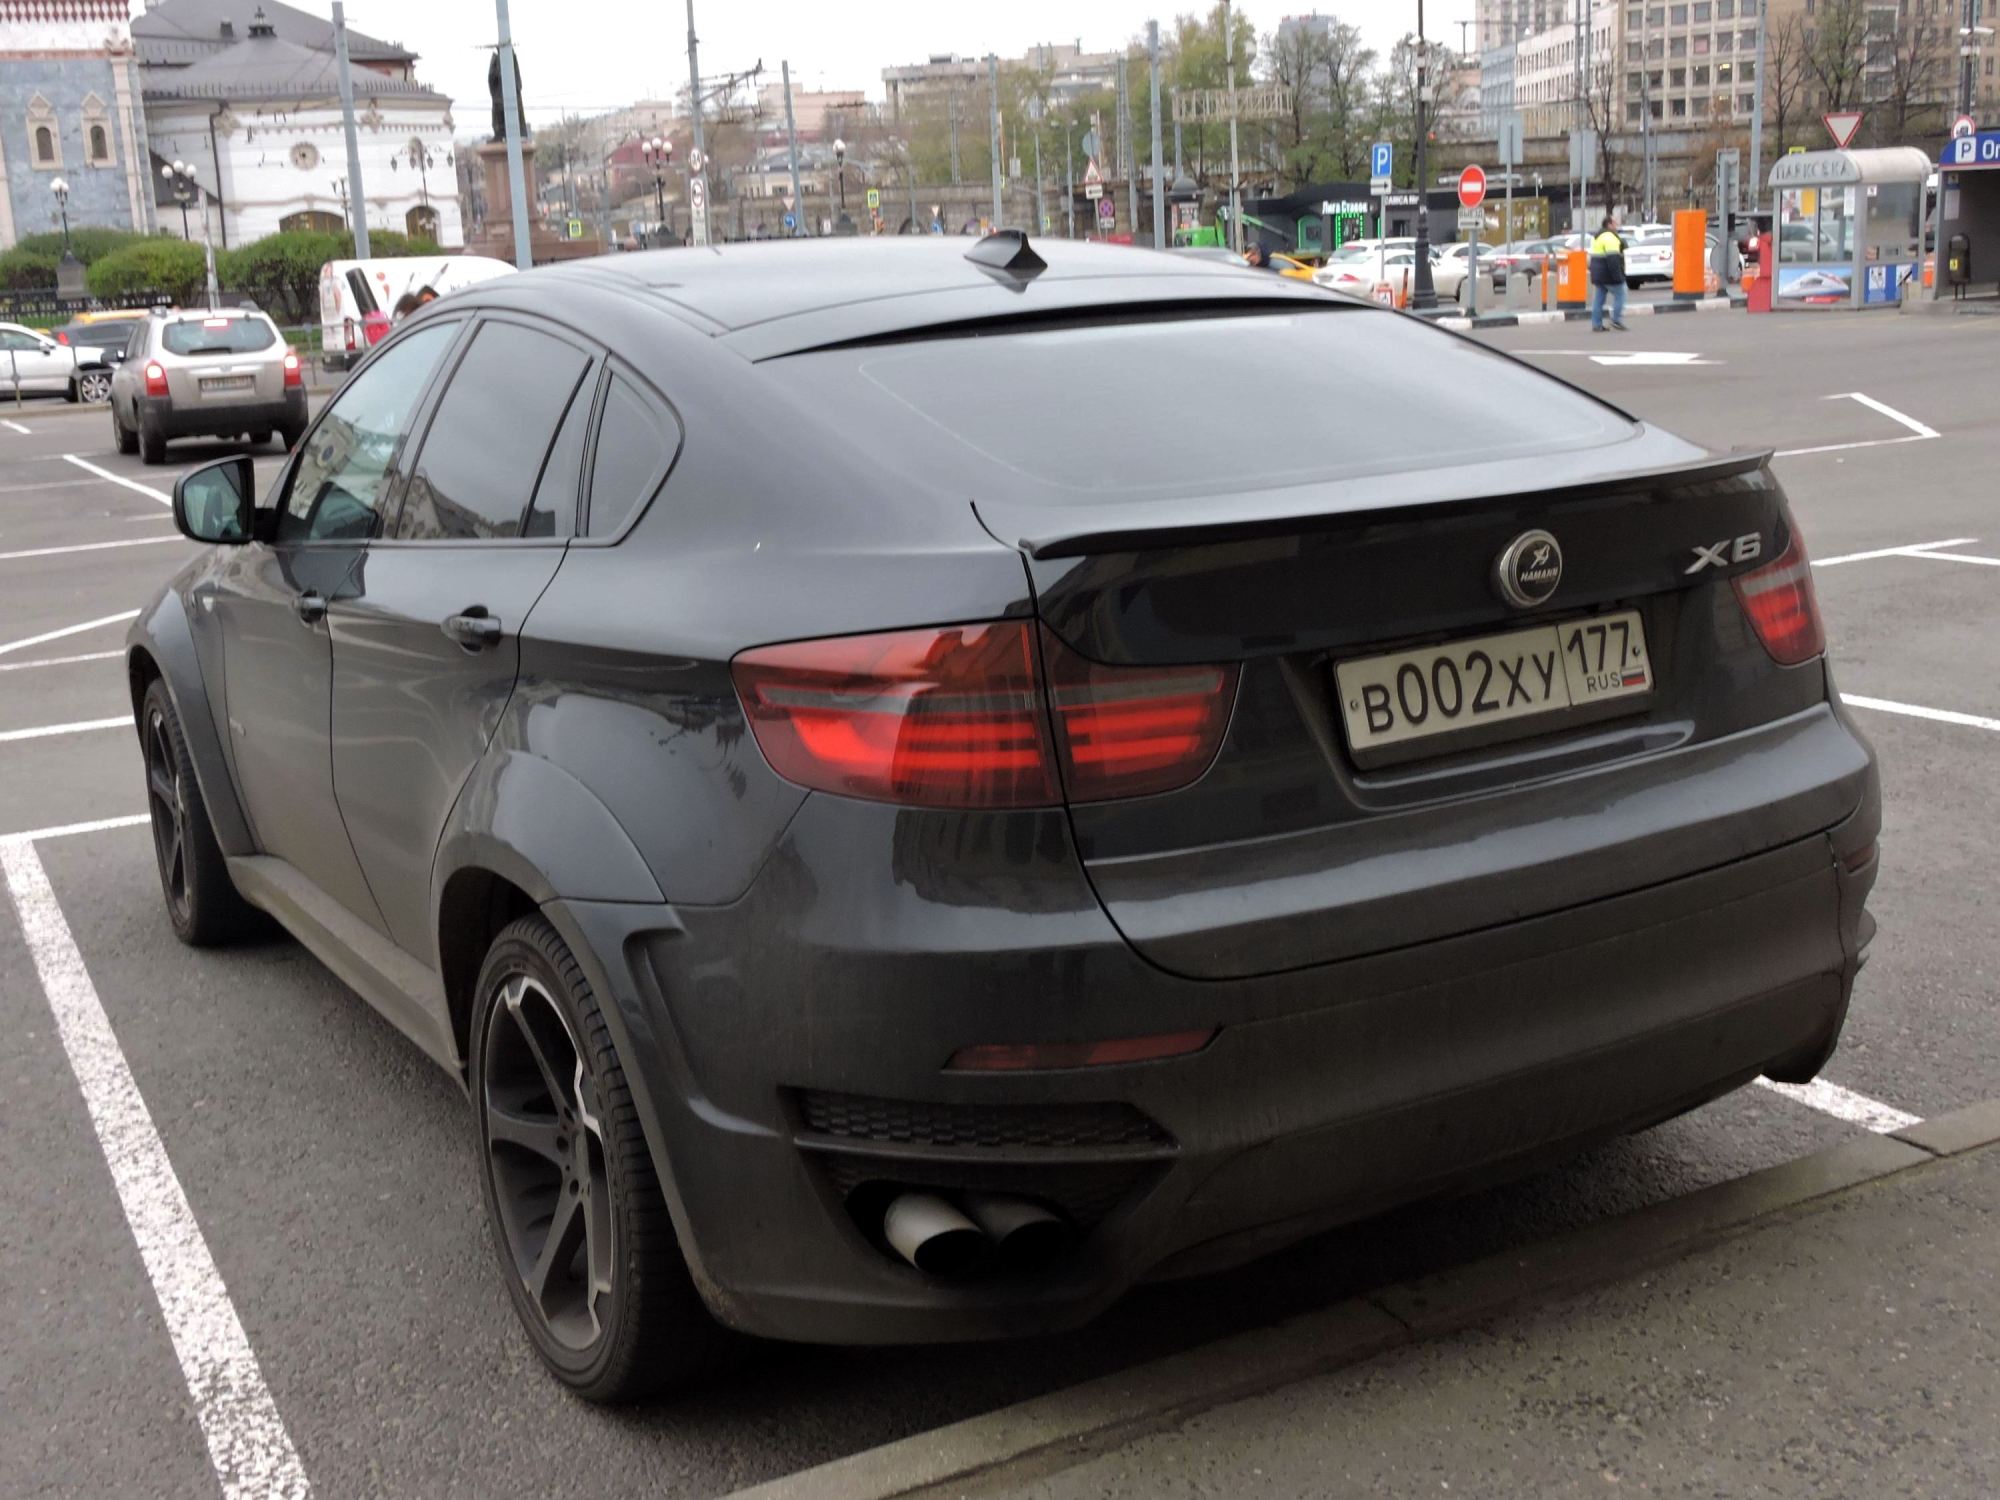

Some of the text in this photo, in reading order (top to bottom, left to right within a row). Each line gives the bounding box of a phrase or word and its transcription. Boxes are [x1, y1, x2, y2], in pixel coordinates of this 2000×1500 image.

[1377, 147, 1388, 174] P
[1683, 531, 1761, 575] X6
[1567, 621, 1629, 675] 177
[1587, 672, 1621, 693] RUS
